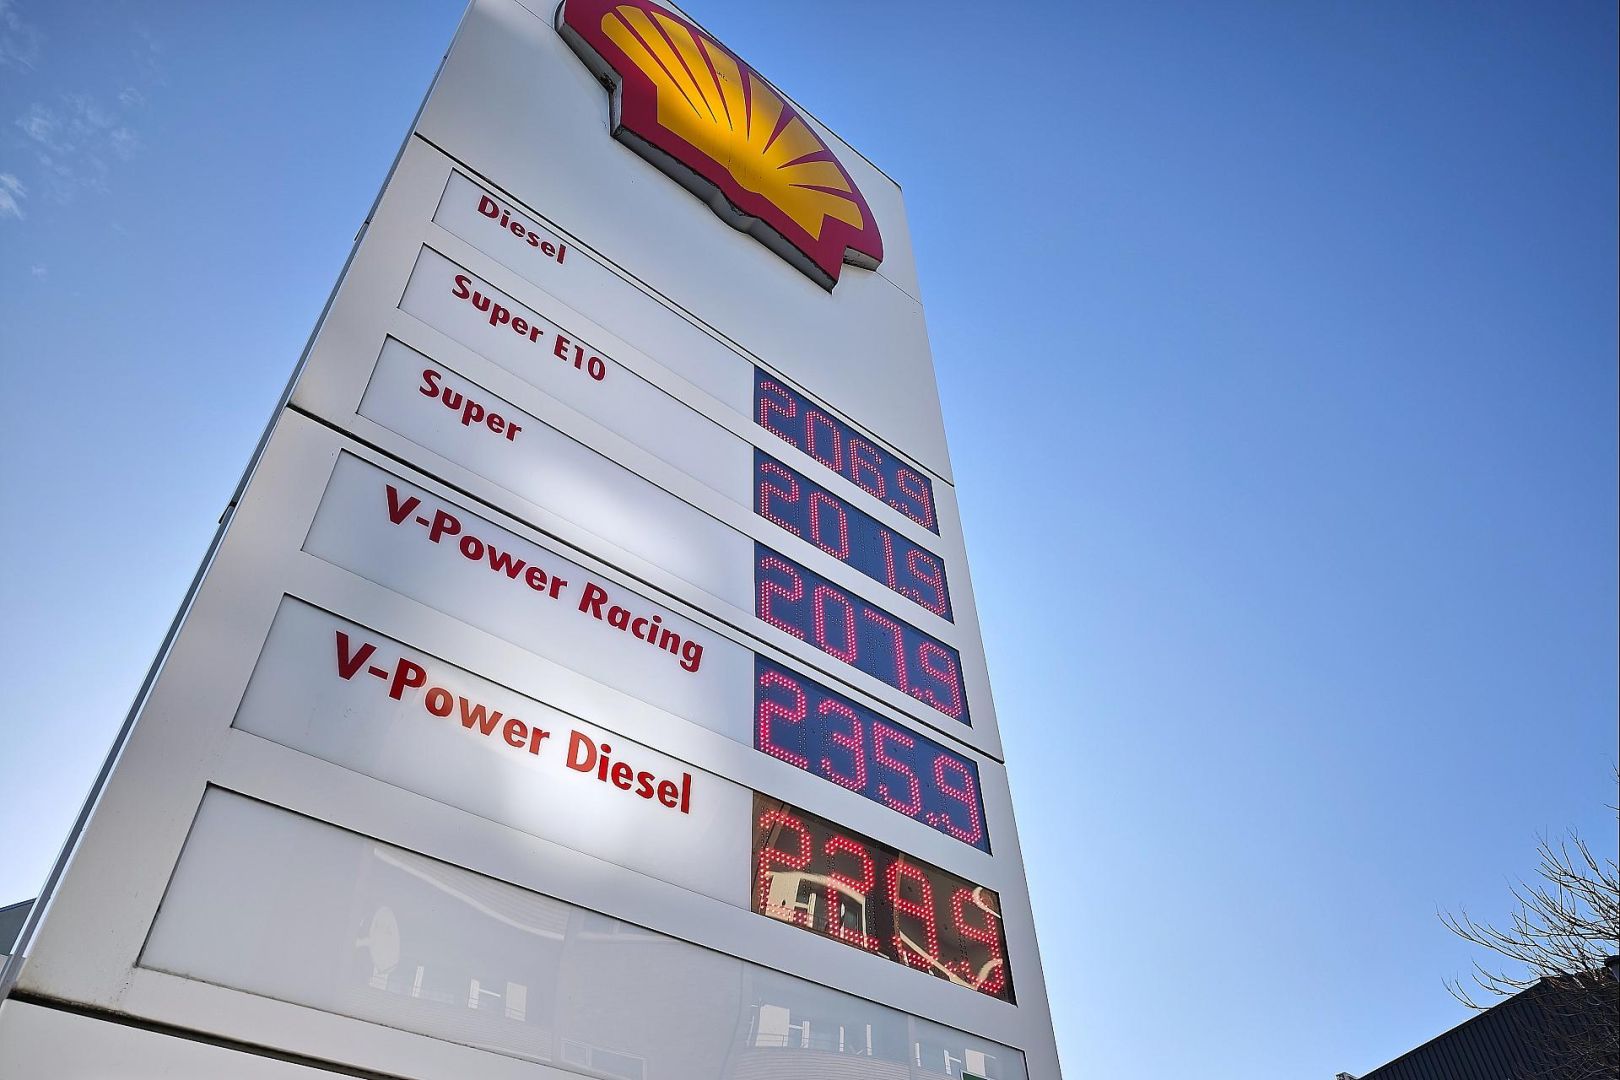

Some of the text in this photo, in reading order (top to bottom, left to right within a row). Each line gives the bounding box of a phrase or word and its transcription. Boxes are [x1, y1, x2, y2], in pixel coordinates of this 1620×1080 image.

[476, 195, 567, 264] Diesel
[452, 274, 607, 382] Super E10
[419, 369, 522, 442] Super
[386, 485, 704, 673] V-Power Racing
[336, 630, 692, 815] V-Power Diesel
